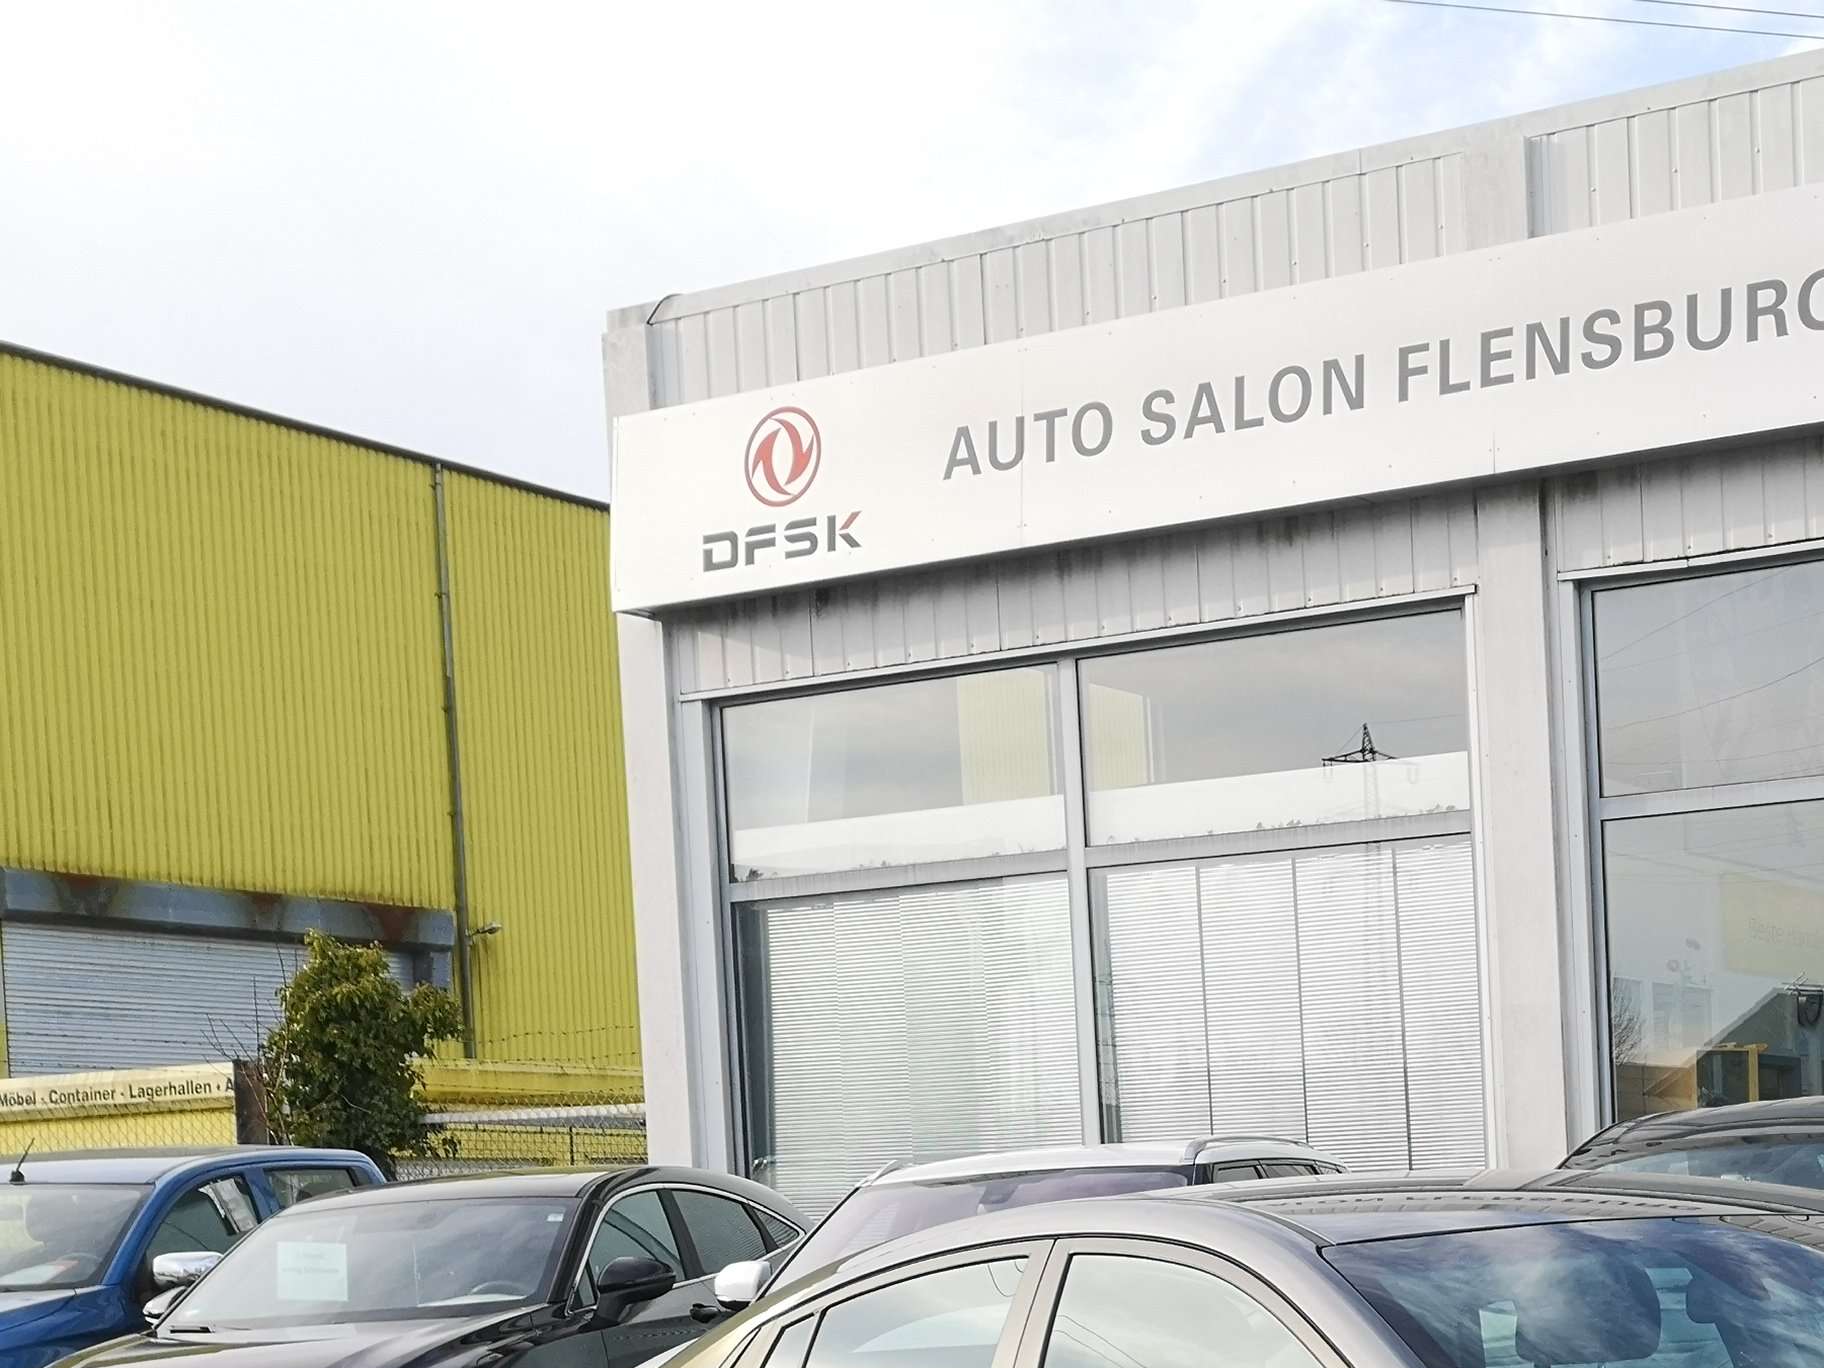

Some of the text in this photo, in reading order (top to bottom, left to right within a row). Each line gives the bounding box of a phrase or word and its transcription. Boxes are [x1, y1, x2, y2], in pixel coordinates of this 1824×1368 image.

[943, 401, 1113, 480] AUTO
[1140, 354, 1364, 446] SALON
[702, 510, 862, 572] DFSK
[0, 1092, 37, 1108] Möbel
[50, 1087, 116, 1105] Container
[129, 1080, 212, 1099] Lagerhallen
